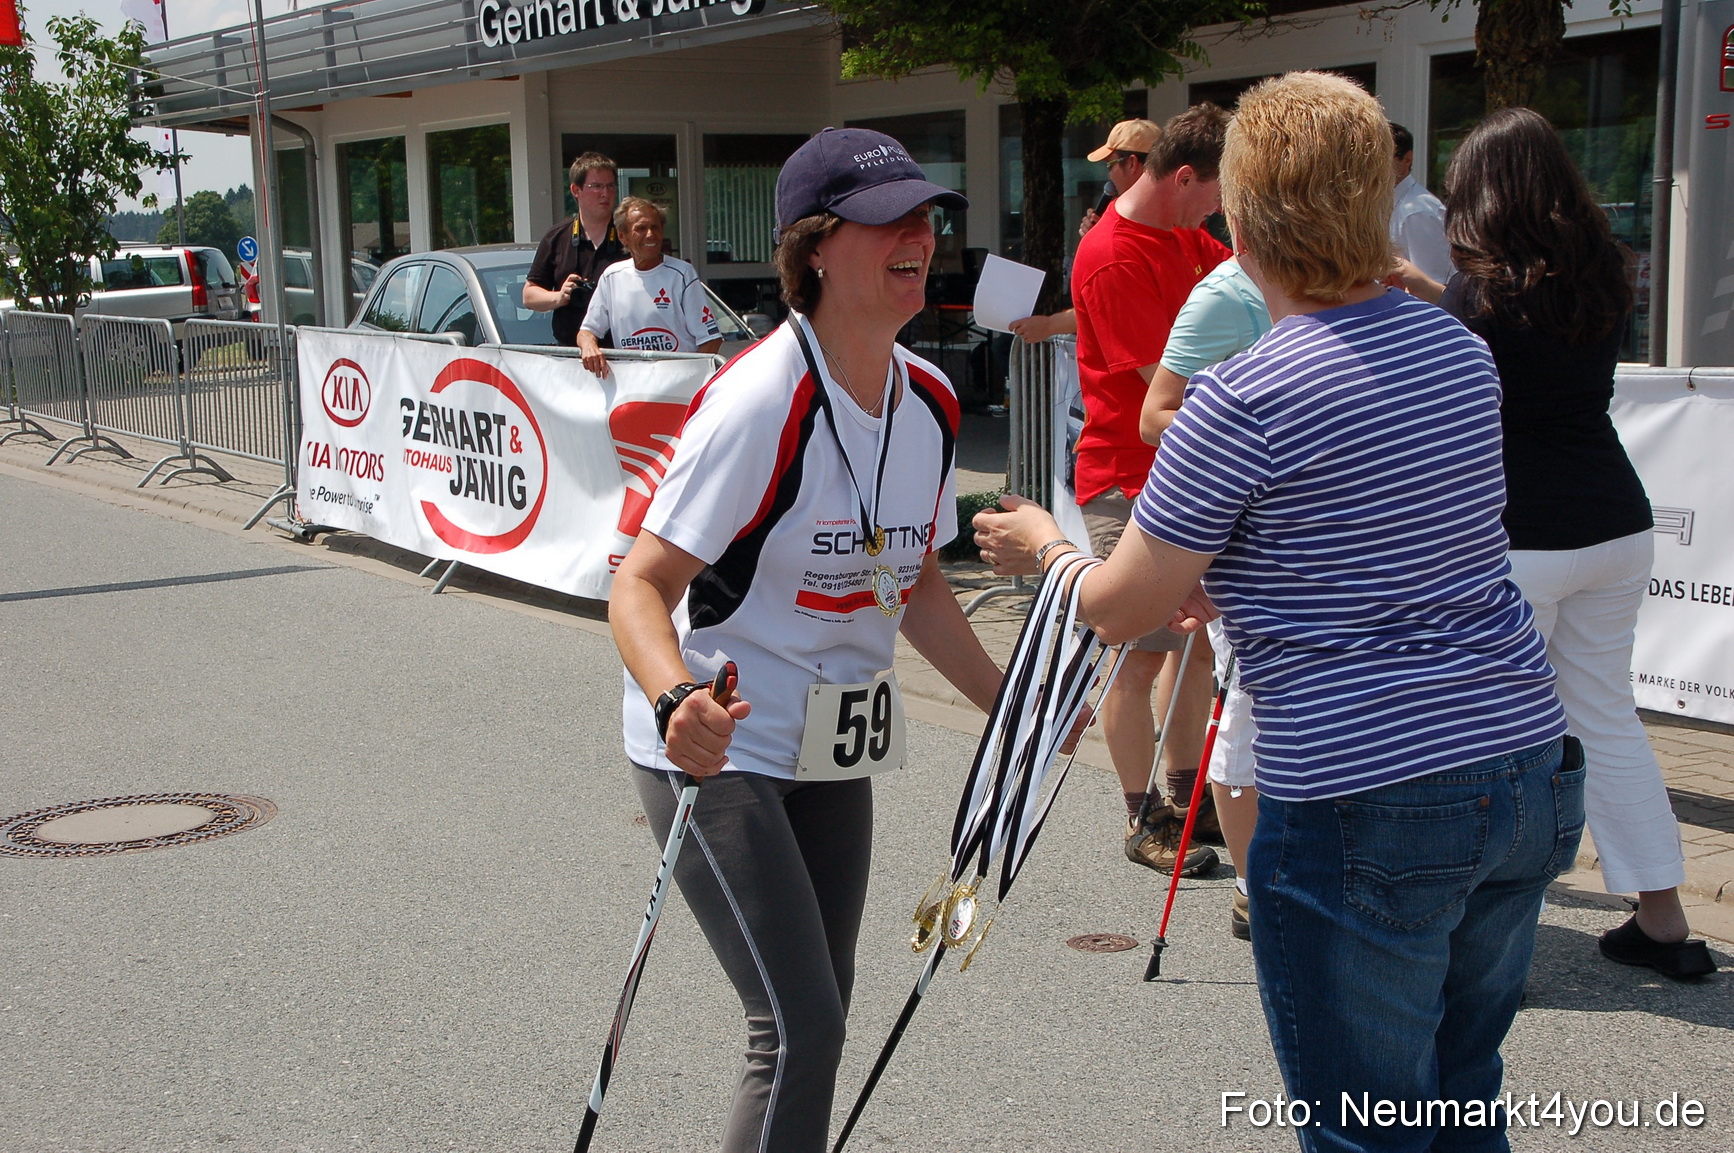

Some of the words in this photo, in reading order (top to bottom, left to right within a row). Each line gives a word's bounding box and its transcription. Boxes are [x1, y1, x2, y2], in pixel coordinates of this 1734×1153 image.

[478, 0, 606, 48] Gerhart
[853, 149, 881, 163] EURO
[620, 335, 664, 347] GERHART
[332, 375, 364, 412] KIA
[400, 397, 506, 458] GERHART
[509, 425, 523, 454] &
[316, 485, 346, 505] Power
[449, 454, 527, 511] JÄNIG
[811, 521, 933, 555] SCHTTNE
[802, 578, 818, 588] Tel.
[804, 570, 860, 581] Regensburger
[860, 569, 871, 577] Str.
[1648, 578, 1686, 600] DAS
[1690, 582, 1734, 607] LEBE
[1638, 673, 1675, 689] MARKE
[1679, 680, 1701, 693] DER
[833, 681, 892, 768] 59
